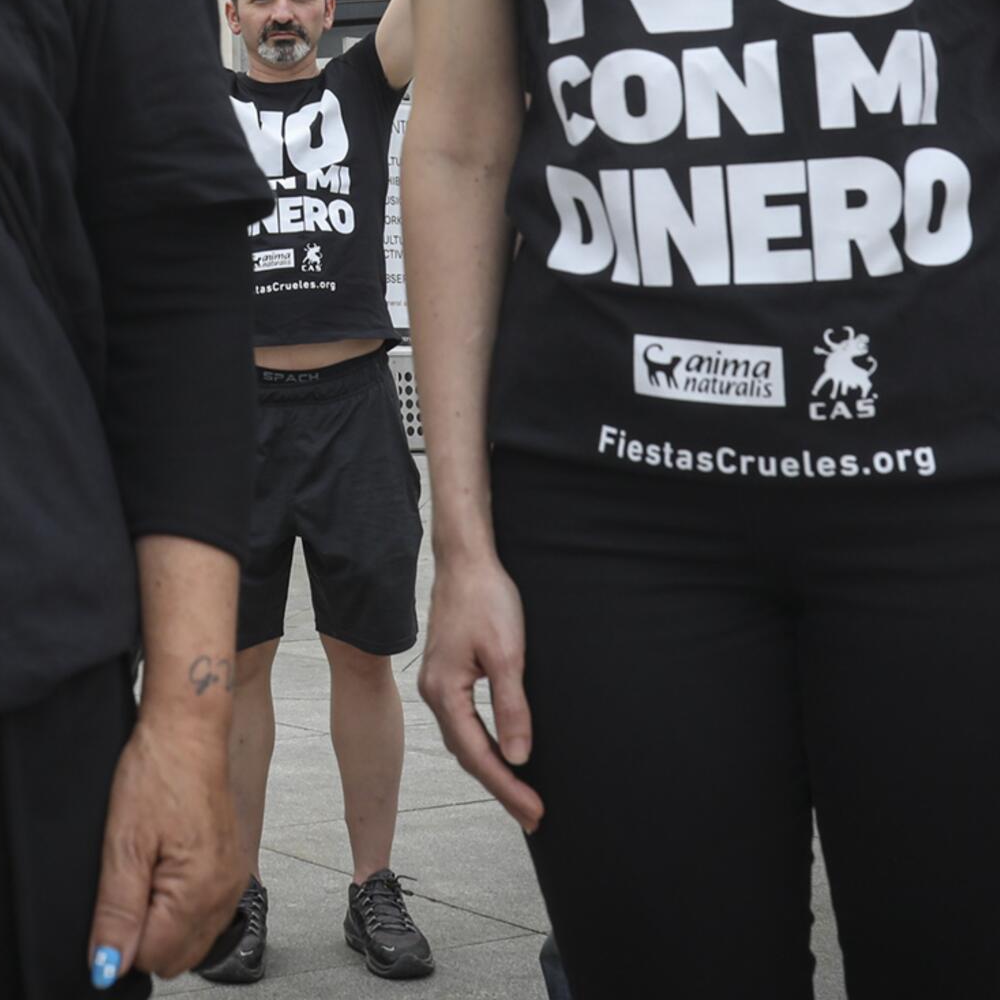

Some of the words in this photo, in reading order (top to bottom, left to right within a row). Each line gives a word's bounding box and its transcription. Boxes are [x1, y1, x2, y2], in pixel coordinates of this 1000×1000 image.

[547, 39, 785, 146] CON
[812, 29, 937, 130] MI
[229, 88, 350, 178] NO
[306, 164, 351, 196] MI
[247, 195, 356, 237] NERO
[546, 147, 973, 287] DINERO
[255, 280, 337, 294] tasCrueles.org
[684, 350, 771, 379] anima
[683, 375, 773, 400] naturalis
[809, 399, 877, 421] CAS
[599, 425, 937, 477] FiestasCrueles.org
